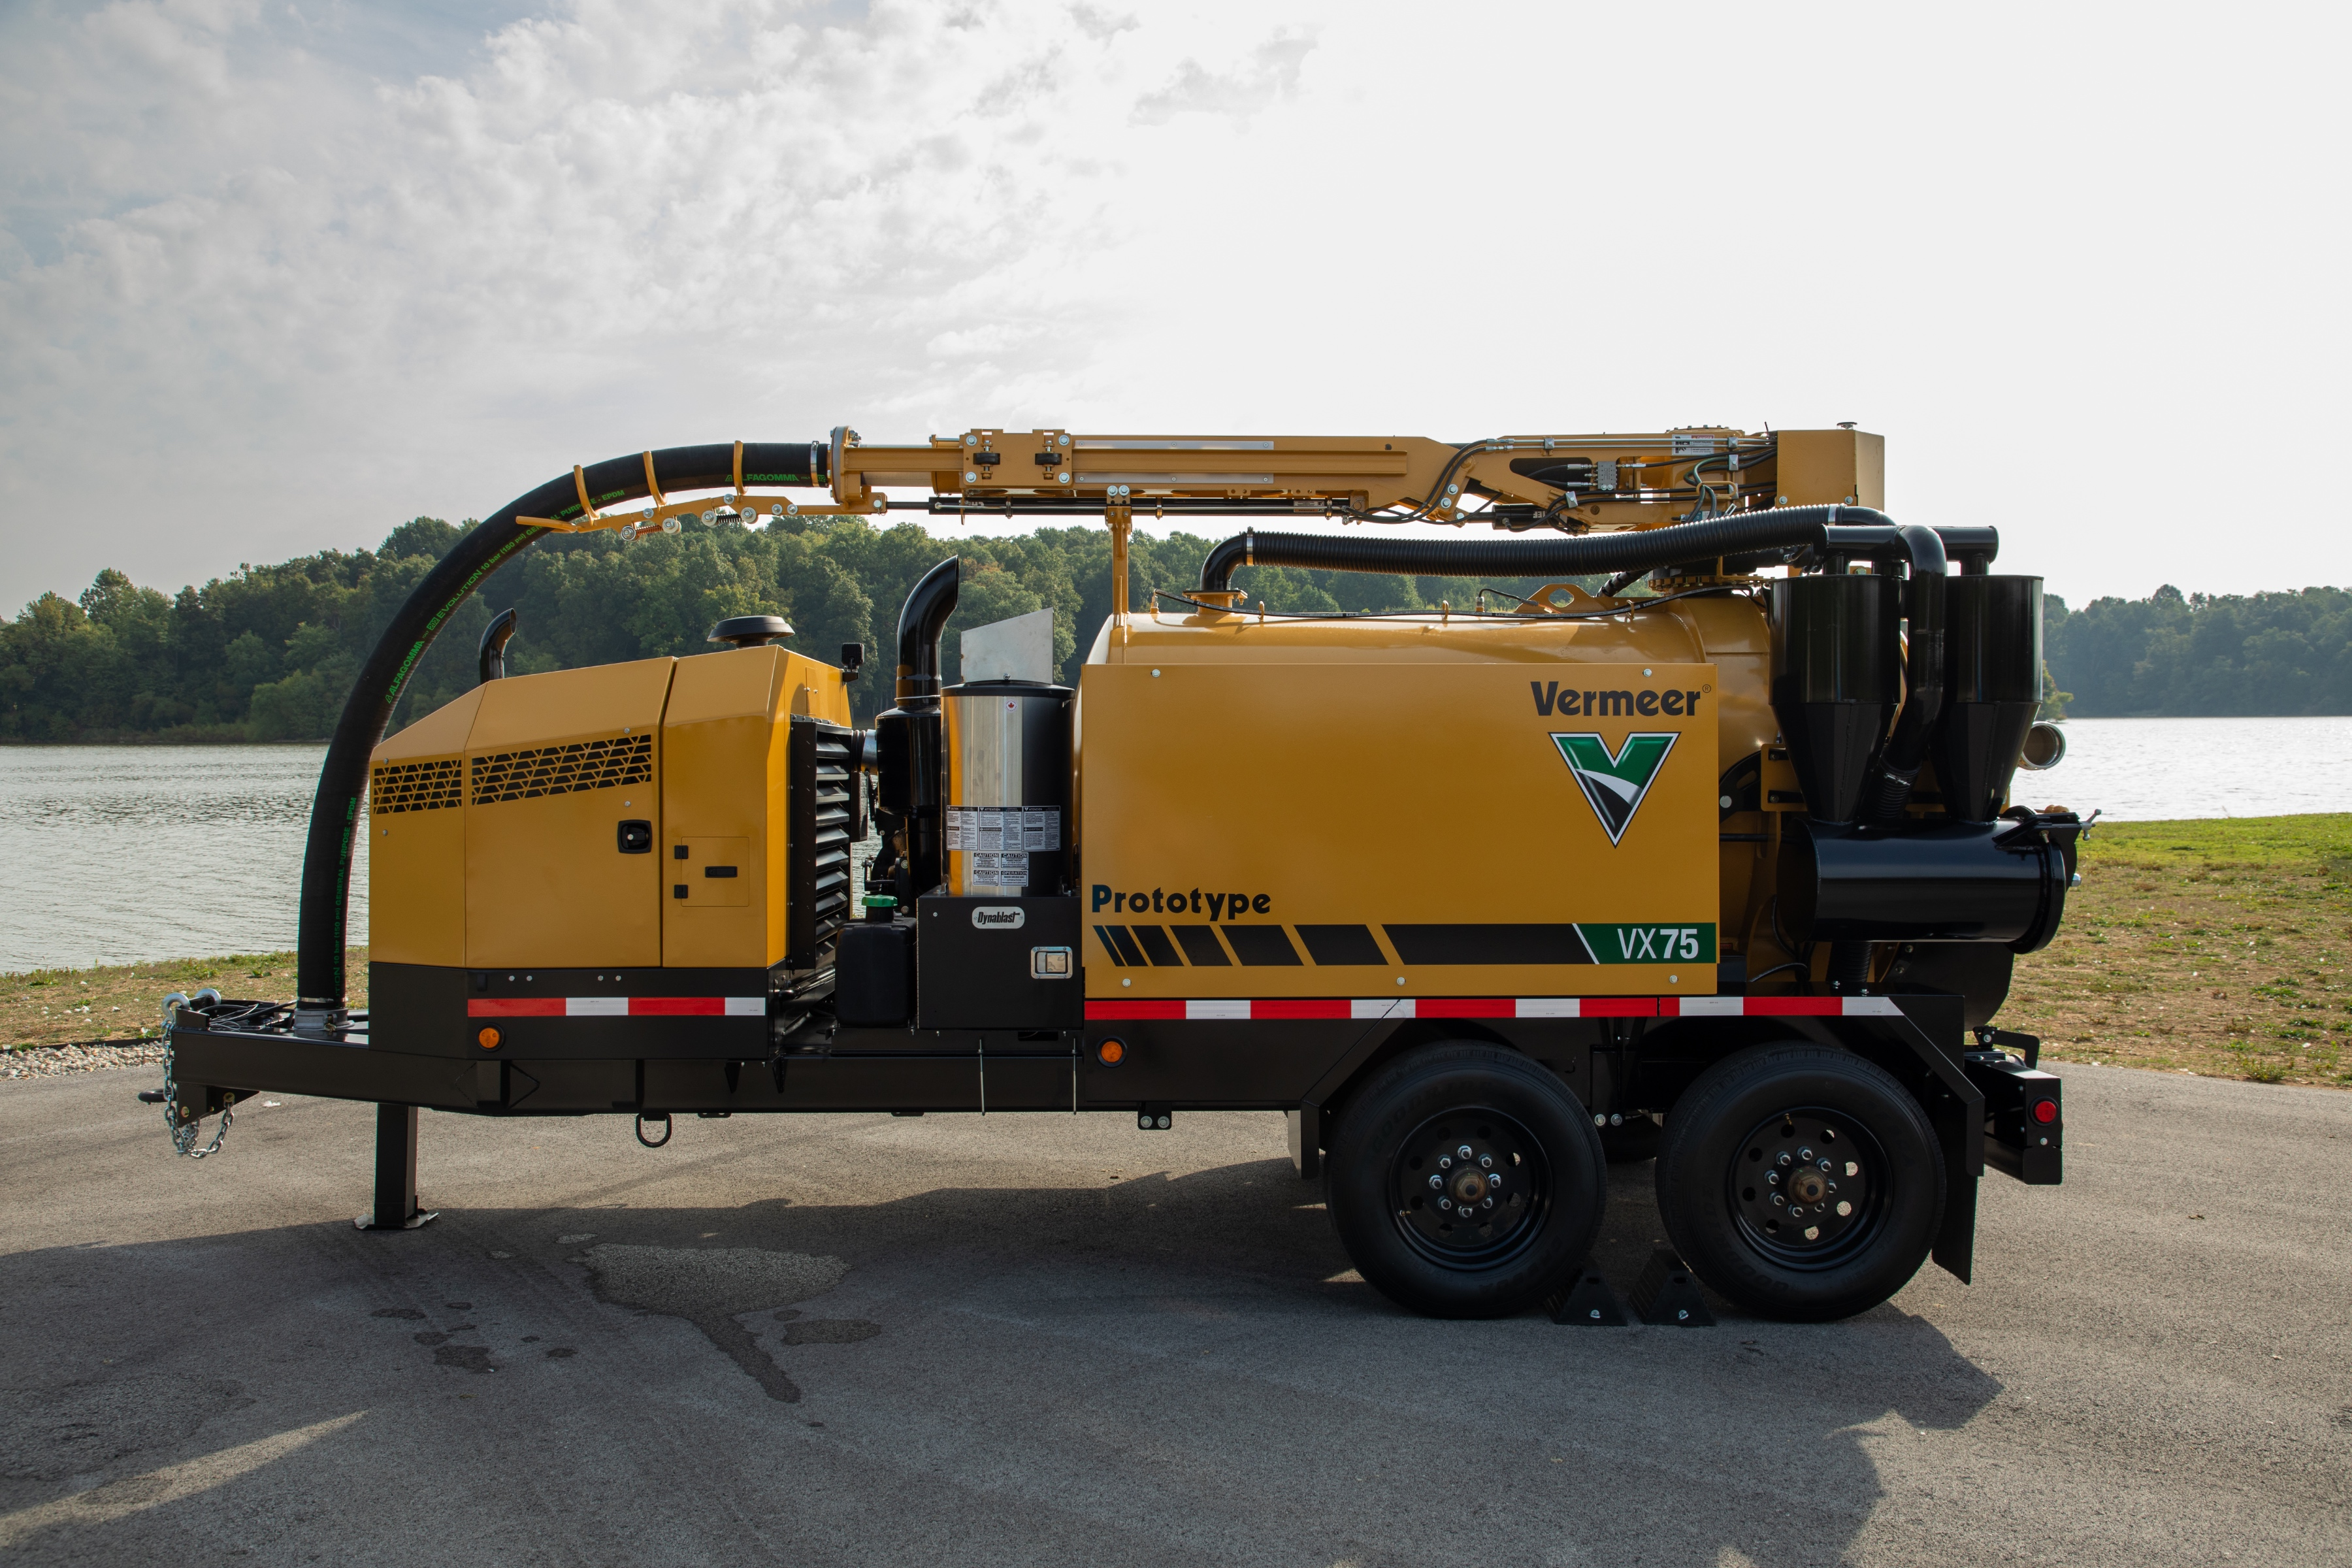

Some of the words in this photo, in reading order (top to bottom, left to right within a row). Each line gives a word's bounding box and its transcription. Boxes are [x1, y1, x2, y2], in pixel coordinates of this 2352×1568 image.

[389, 640, 425, 696] ALFAGOMMA
[427, 617, 440, 630] 202
[436, 569, 483, 619] EVOLUTION
[481, 562, 490, 571] 10
[488, 552, 500, 564] bar
[500, 542, 515, 555] (150
[515, 533, 527, 544] psi)
[526, 515, 561, 536] GENAL
[560, 498, 597, 517] PURPE
[601, 490, 625, 501] EPDM
[1530, 681, 1701, 717] Vermeer
[346, 796, 357, 820] EPDM
[340, 826, 351, 865] PURPOSE
[335, 867, 345, 906] GENERAL
[1092, 884, 1271, 922] Prototype
[977, 911, 1021, 925] Dynablast
[334, 955, 340, 964] 10
[1701, 1184, 1789, 1294] GOODRIDE
